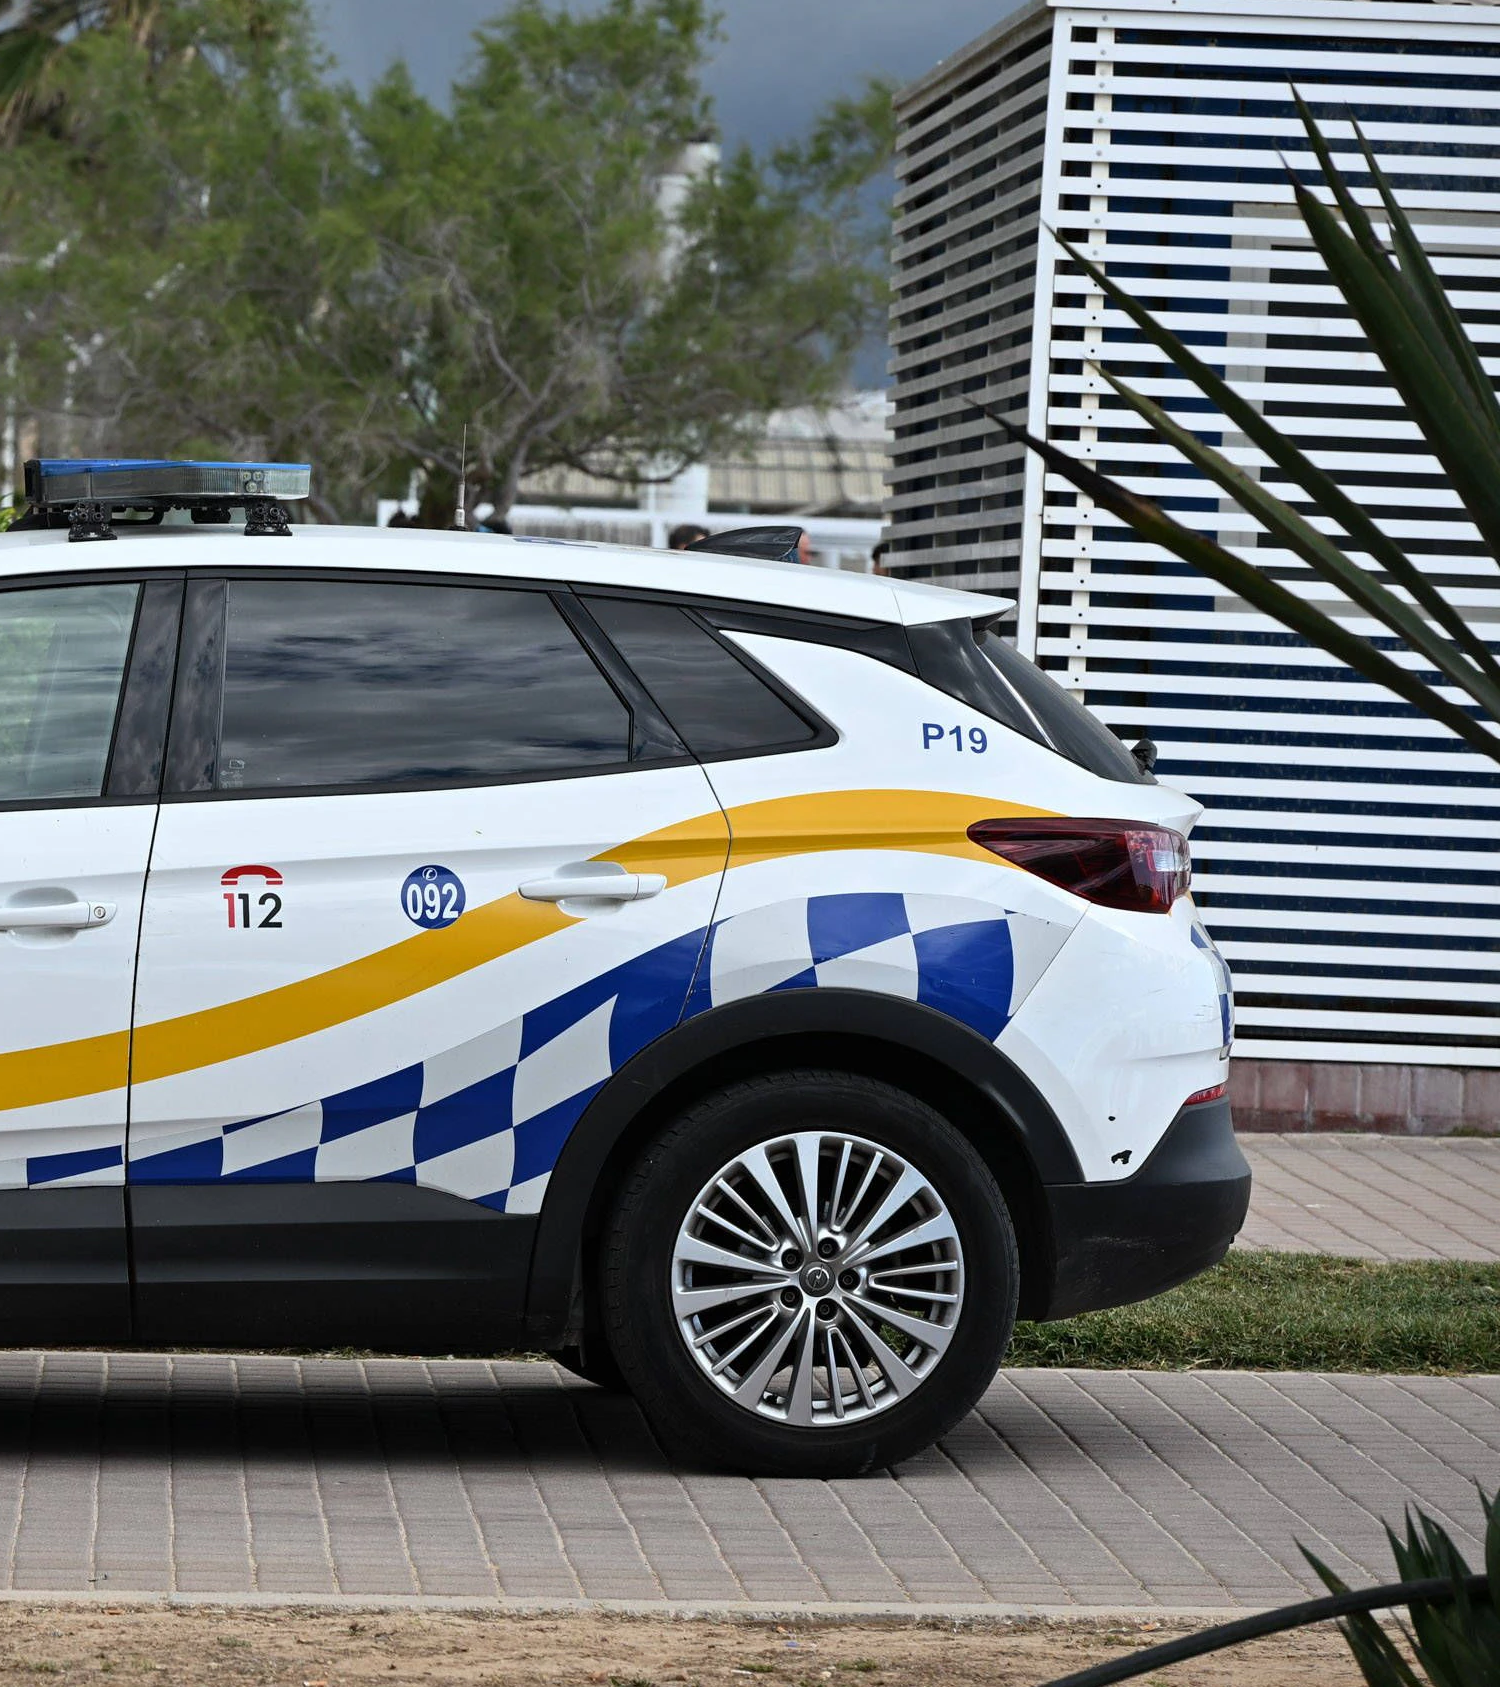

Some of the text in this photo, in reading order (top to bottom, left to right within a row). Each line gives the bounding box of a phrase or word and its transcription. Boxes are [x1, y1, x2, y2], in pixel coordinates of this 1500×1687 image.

[922, 722, 988, 754] P19
[223, 892, 283, 929] 112
[406, 882, 459, 920] 092
